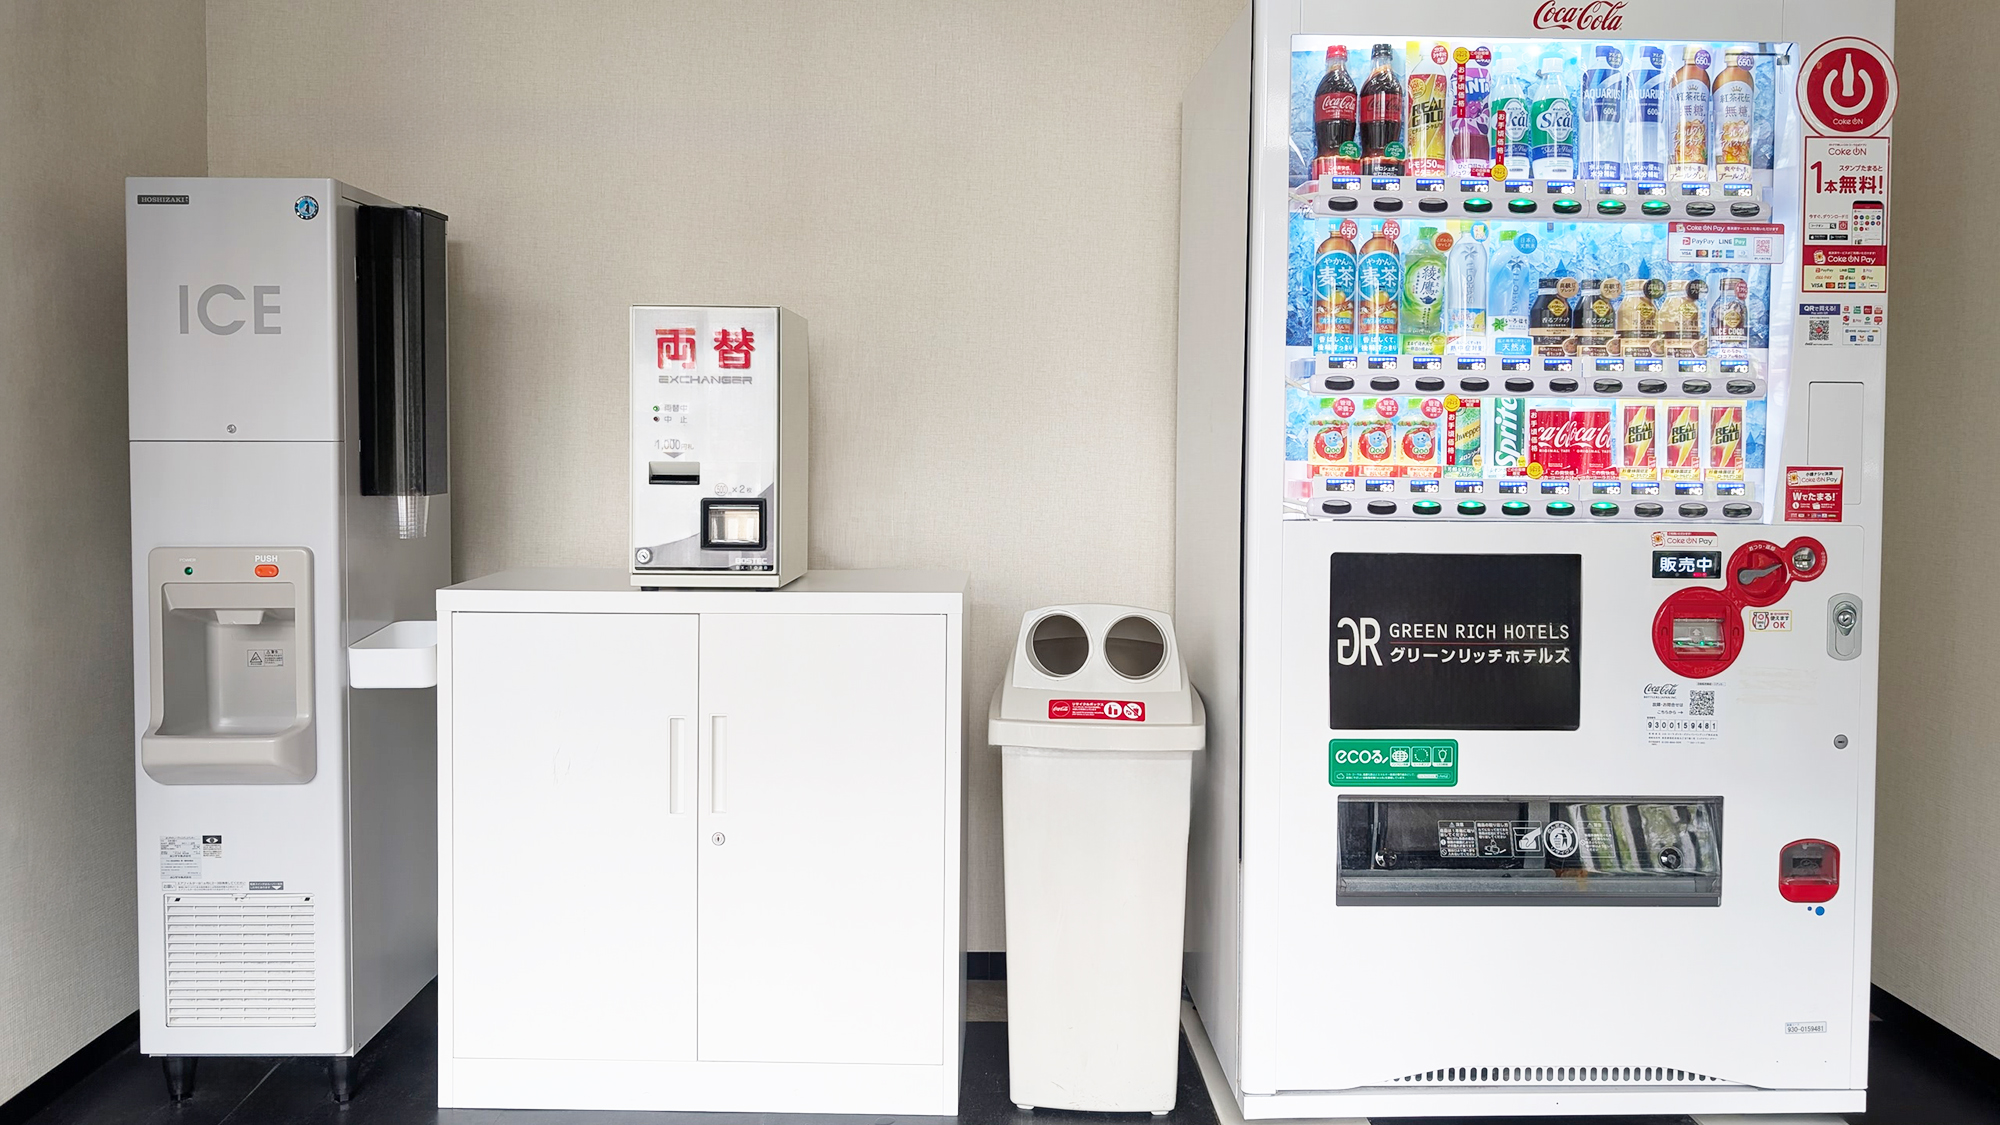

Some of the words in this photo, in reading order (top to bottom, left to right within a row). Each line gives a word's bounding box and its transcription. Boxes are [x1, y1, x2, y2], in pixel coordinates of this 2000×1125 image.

[1533, 0, 1628, 31] Coca-Cola
[1584, 88, 1621, 100] AQUARIUS
[1627, 88, 1664, 100] AQUARIUS
[1676, 92, 1706, 102] 紅茶花伝
[1719, 92, 1750, 103] 紅茶花伝
[1322, 95, 1357, 111] Coca-Cola
[1412, 97, 1443, 116] REAL
[1725, 105, 1750, 118] 無糖
[1412, 110, 1444, 128] GOLD
[1852, 117, 1864, 125] ON
[1828, 148, 1851, 156] Coke
[1852, 147, 1867, 156] ON
[1838, 164, 1883, 172] スタンプたまると
[1810, 161, 1883, 195] 1本無料!
[141, 196, 186, 204] HOSHIZAKI
[1341, 227, 1356, 236] 650
[1384, 227, 1399, 236] 650
[1703, 224, 1713, 232] ON
[1713, 225, 1726, 233] Pay
[1827, 256, 1847, 264] Coke
[1848, 255, 1861, 264] ON
[1861, 256, 1876, 265] Pay
[1317, 266, 1355, 287] 麦茶
[1360, 266, 1398, 287] 麦茶
[1420, 265, 1437, 297] 綾鷹
[178, 284, 281, 335] ICE
[655, 326, 755, 369] 両替
[1502, 343, 1528, 352] 天然水
[658, 376, 753, 385] EXCHANGER
[664, 404, 688, 413] 両替中
[1495, 398, 1519, 467] Sprite
[1628, 421, 1653, 435] REAL
[1671, 421, 1696, 435] REAL
[1715, 421, 1740, 436] REAL
[1448, 413, 1456, 463] お手頃価格!
[1530, 411, 1538, 461] お手頃価格!
[1628, 431, 1653, 444] GOLD
[1671, 432, 1696, 445] GOLD
[1715, 432, 1740, 445] GOLD
[1324, 446, 1341, 454] Qoo
[1368, 446, 1385, 454] Qoo
[1412, 446, 1429, 454] Qoo
[1792, 492, 1836, 501] Wでたまる!
[1666, 537, 1686, 545] Coke
[1686, 537, 1698, 545] ON
[1698, 538, 1713, 547] Pay
[255, 555, 278, 563] PUSH
[1659, 556, 1713, 573] 販売中
[1389, 623, 1448, 639] GREEN
[1455, 623, 1496, 639] RICH
[1504, 624, 1570, 640] HOTELS
[1389, 647, 1570, 665] グリーンリッチホテルズ
[1643, 683, 1680, 695] Coca-Cola
[1648, 721, 1716, 730] 9300159481
[1787, 1025, 1824, 1033] 930-0159481
